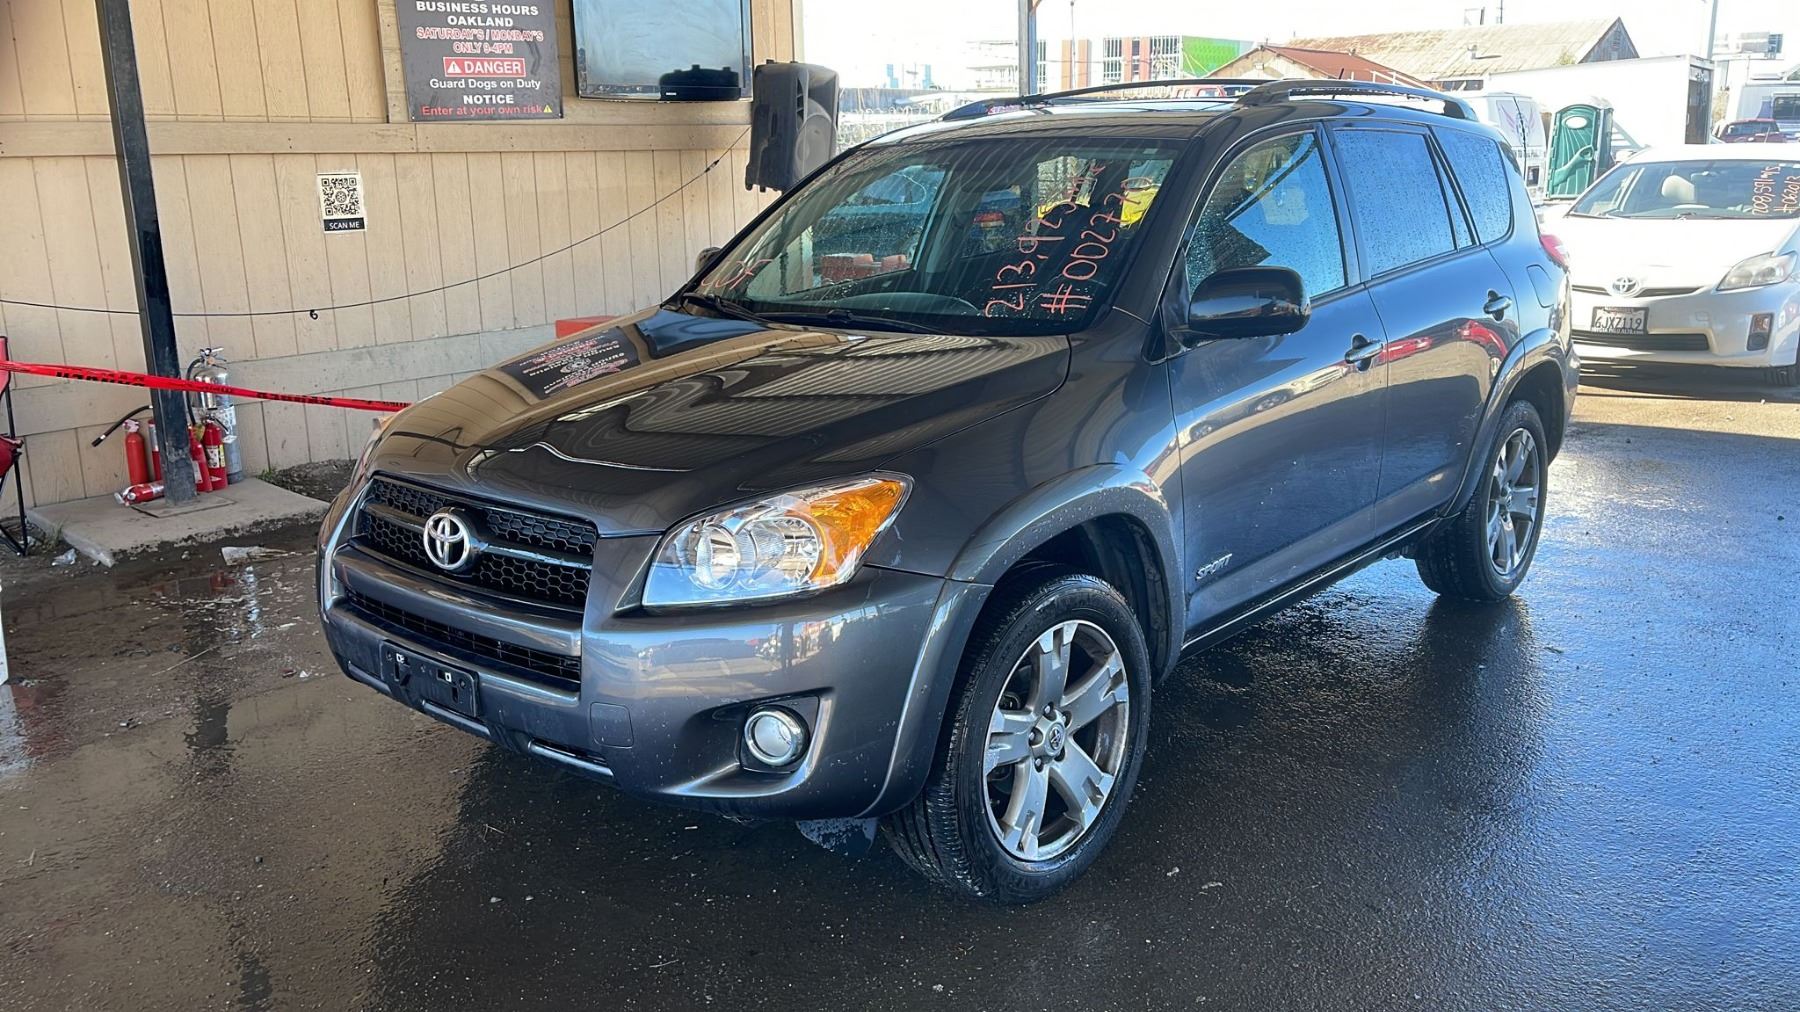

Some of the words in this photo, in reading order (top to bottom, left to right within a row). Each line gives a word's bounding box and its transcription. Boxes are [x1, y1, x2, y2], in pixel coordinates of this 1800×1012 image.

[416, 1, 488, 13] BUSINESS
[492, 4, 539, 16] HOURS
[447, 15, 514, 27] OAKLAND
[453, 41, 482, 54] ONLY
[483, 42, 514, 54] 9-4PM
[463, 61, 522, 74] DANGER
[429, 78, 466, 89] Guard
[468, 79, 498, 90] Dogs
[500, 80, 514, 88] on
[516, 79, 541, 90] Duty
[463, 94, 515, 105] NOTICE
[422, 105, 454, 116] Enter
[456, 106, 468, 116] at
[470, 106, 495, 117] your
[498, 106, 521, 114] own
[523, 105, 542, 114] risk
[329, 222, 348, 230] SCAN
[349, 221, 360, 229] ME
[1196, 552, 1233, 580] SPORT
